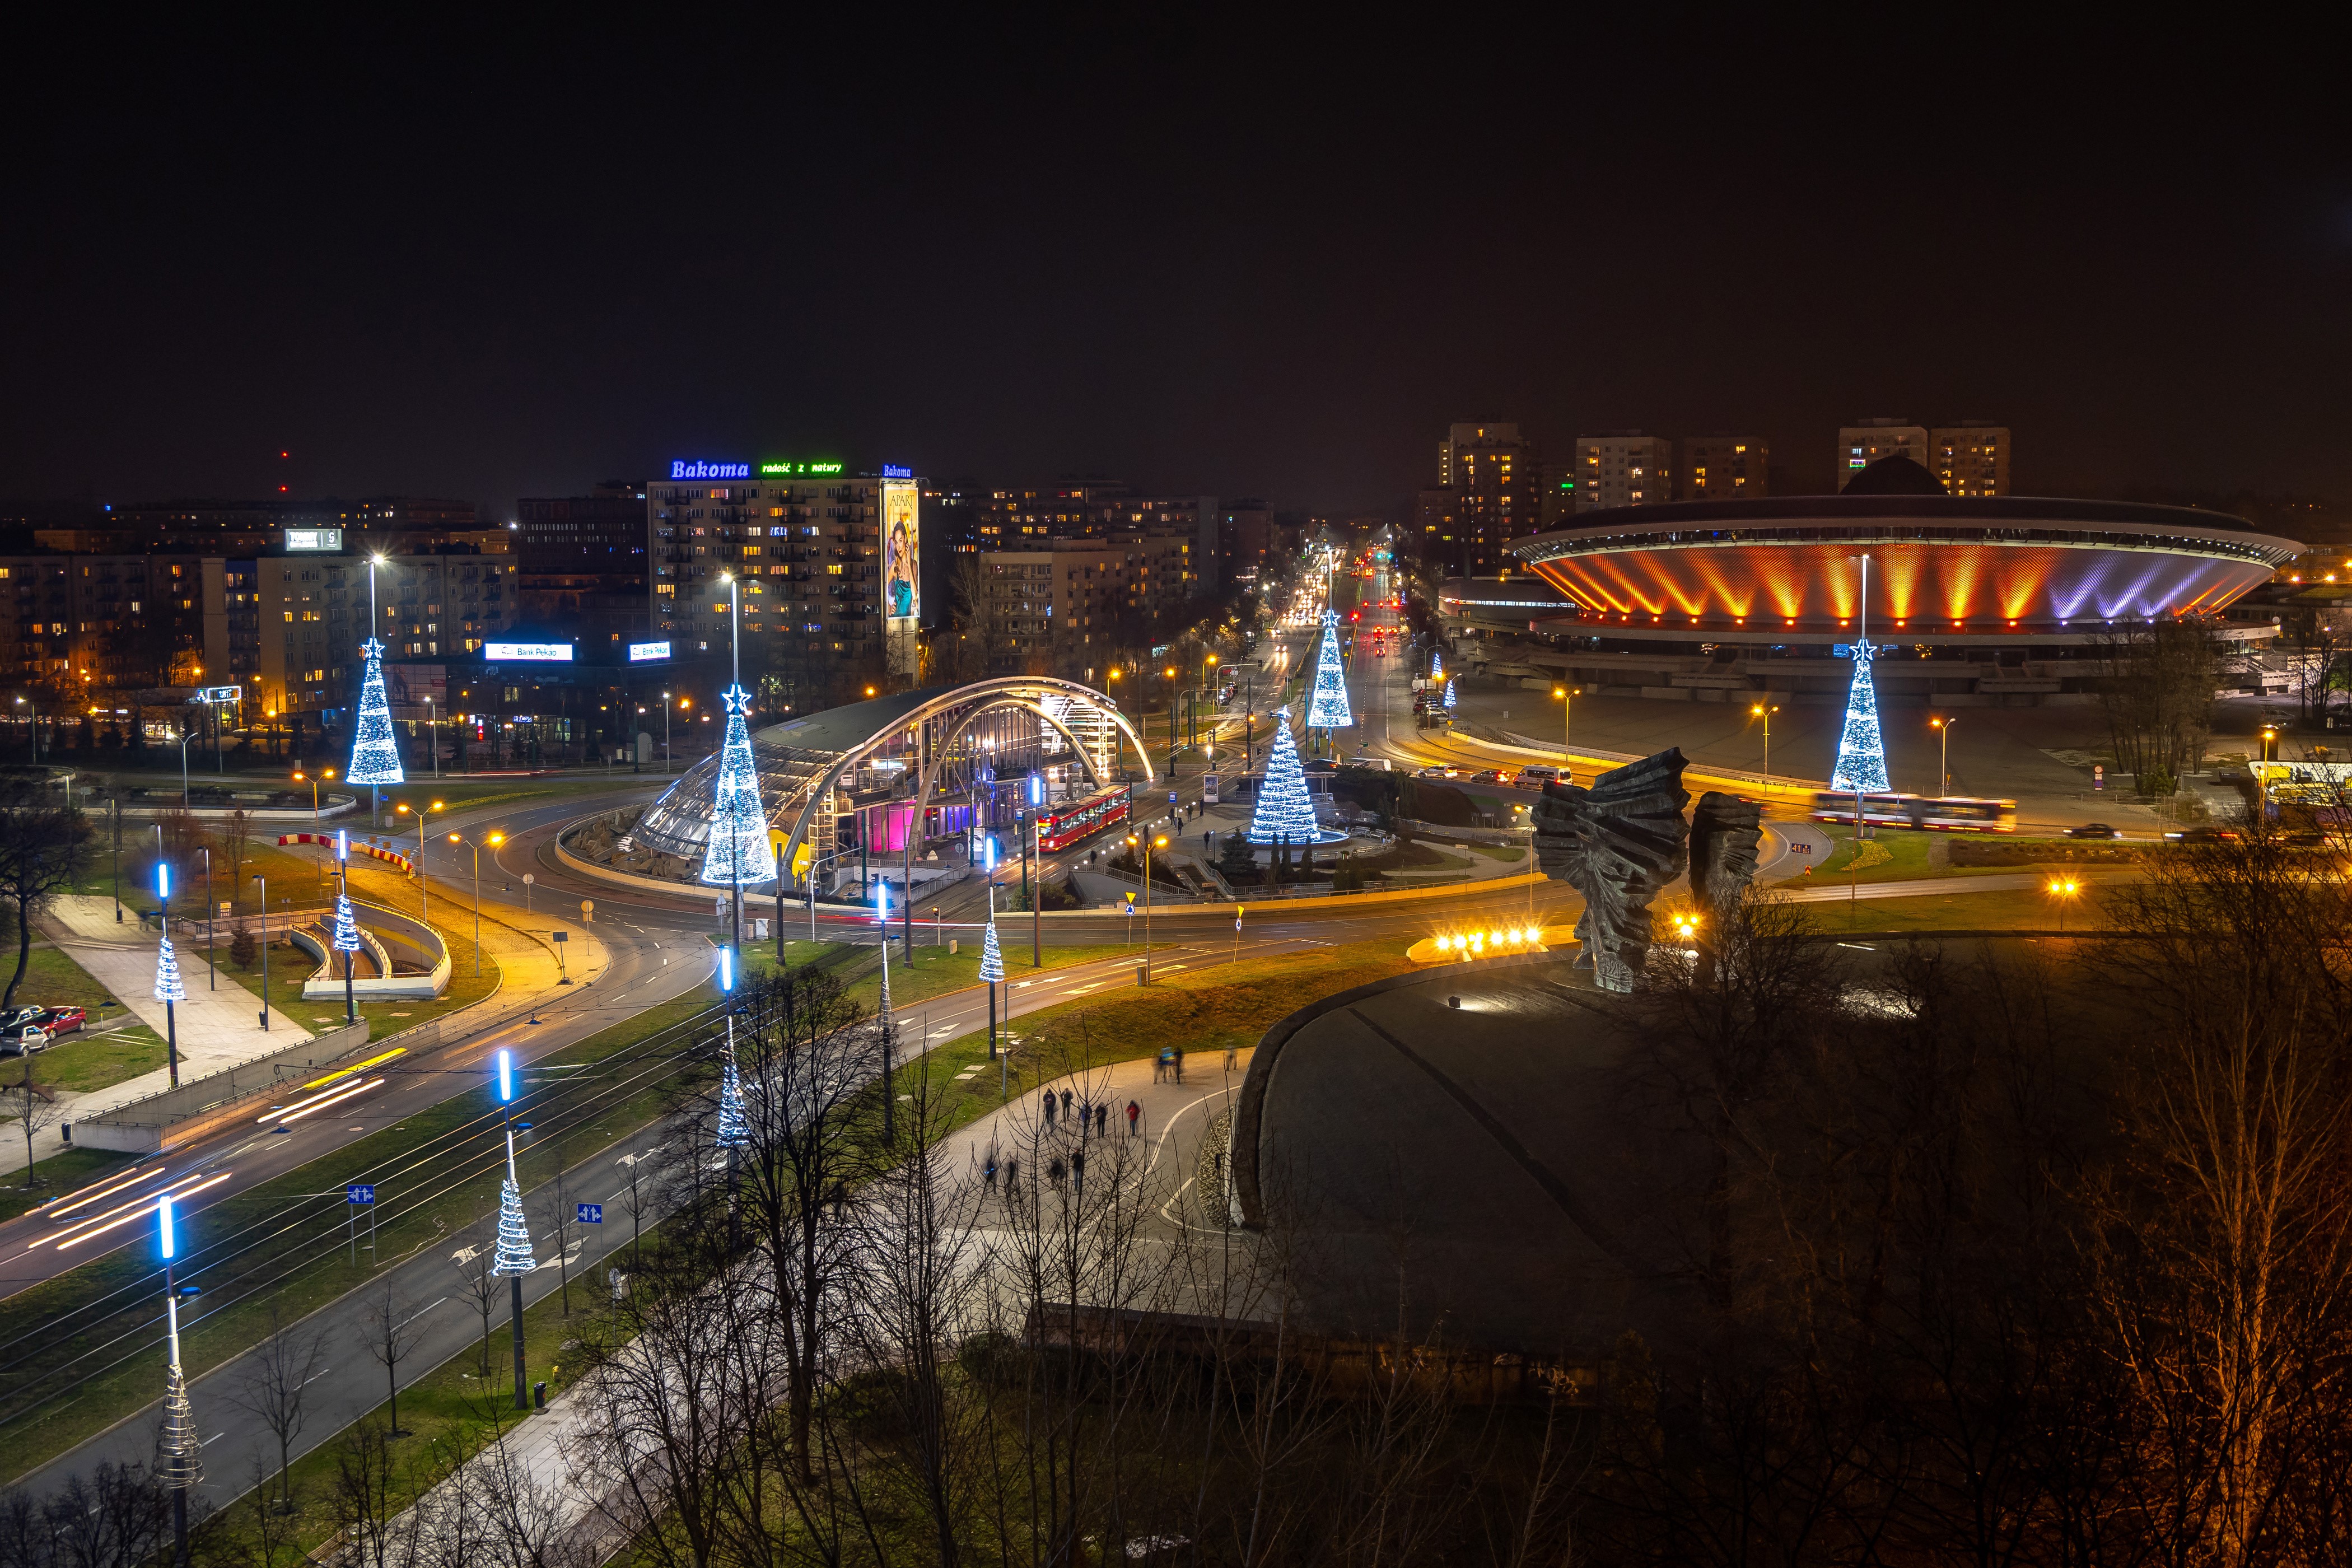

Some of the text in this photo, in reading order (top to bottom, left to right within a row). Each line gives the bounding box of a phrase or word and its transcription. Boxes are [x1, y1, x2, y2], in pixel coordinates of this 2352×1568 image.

[672, 461, 748, 477] Bakoma
[762, 463, 791, 473] radość
[812, 463, 842, 473] natury
[884, 464, 911, 478] Bakoma
[890, 495, 914, 509] APART
